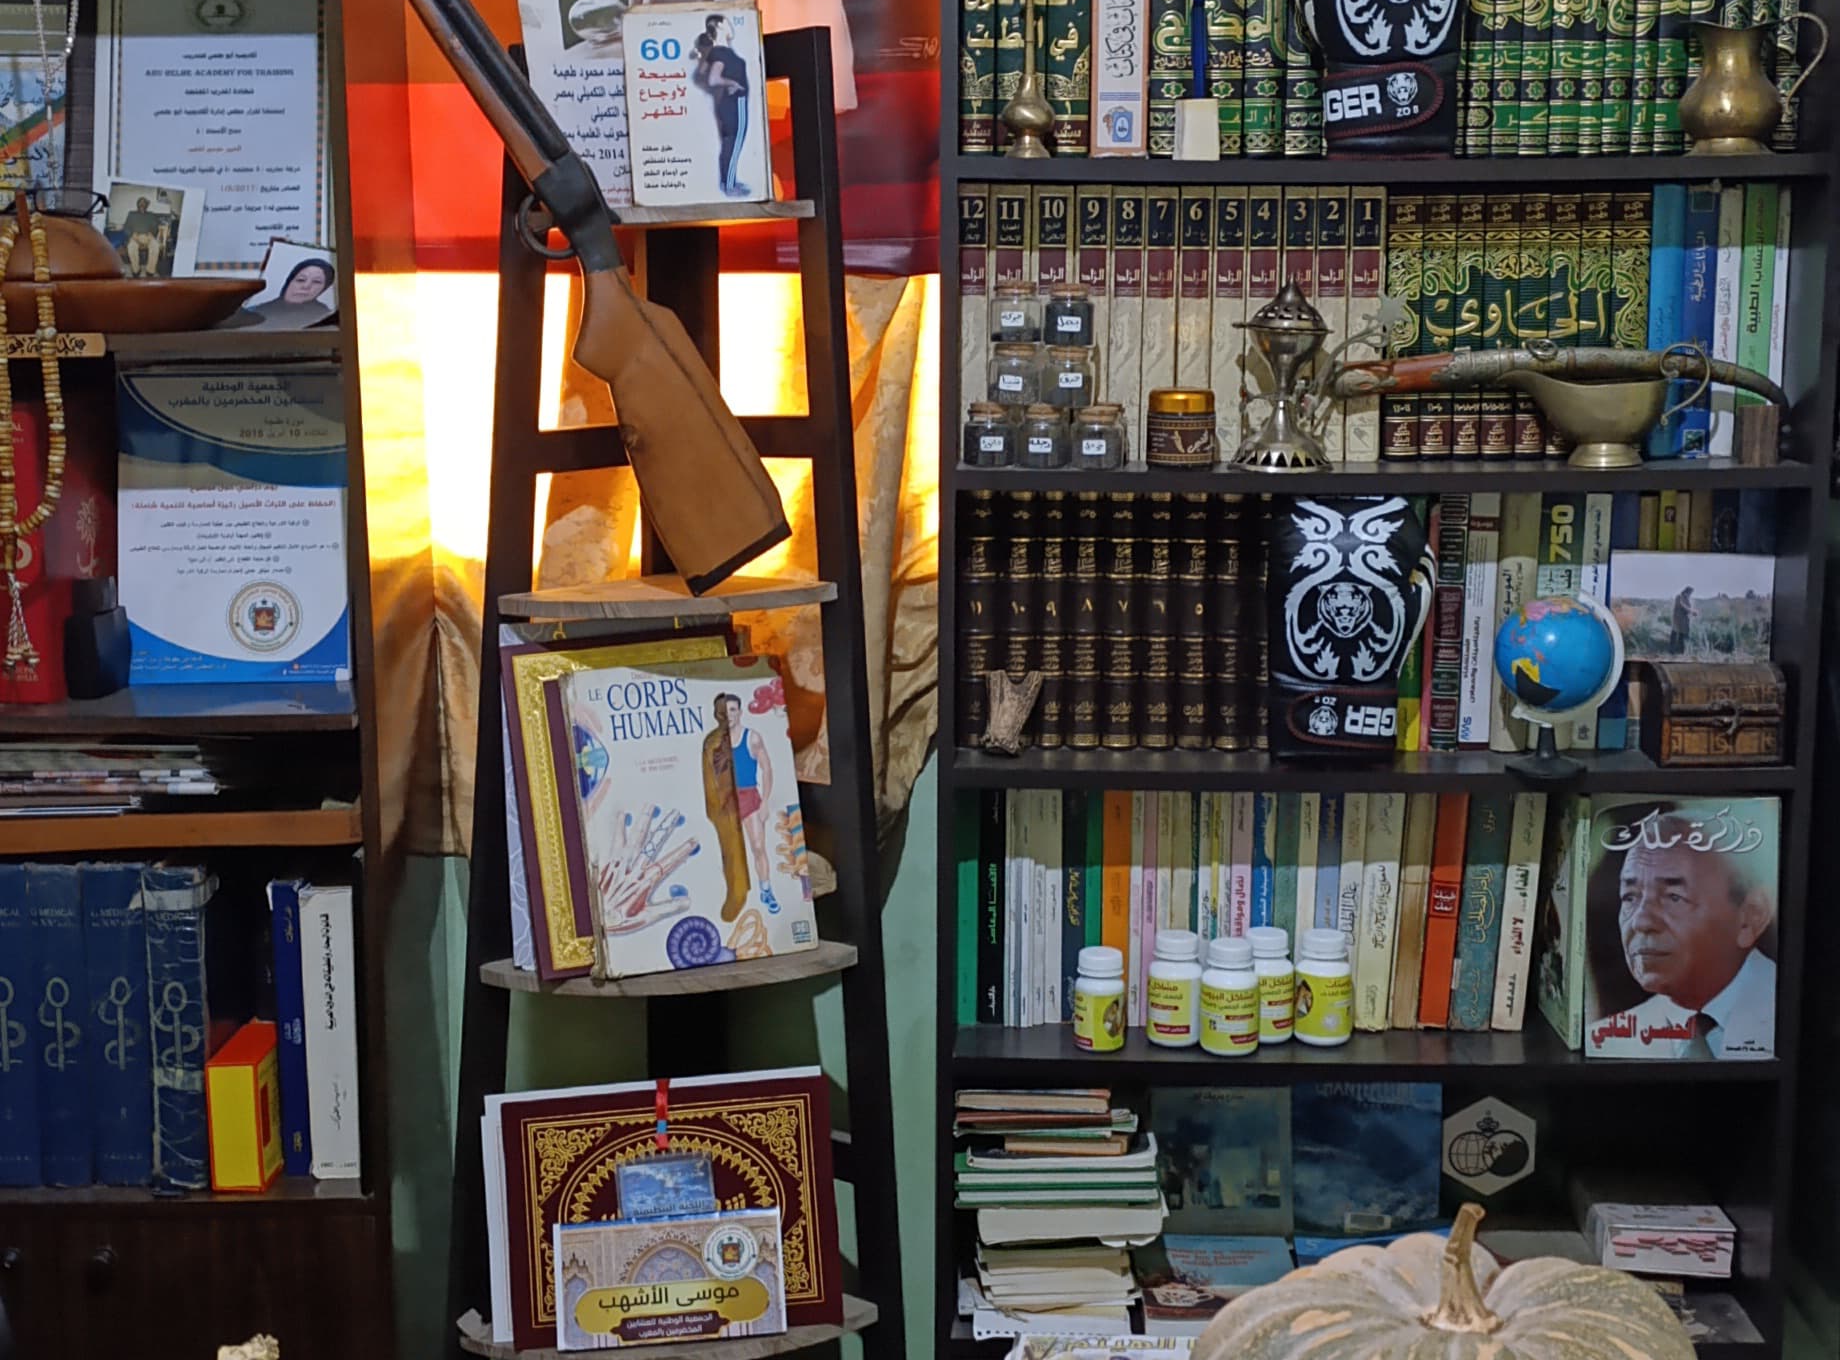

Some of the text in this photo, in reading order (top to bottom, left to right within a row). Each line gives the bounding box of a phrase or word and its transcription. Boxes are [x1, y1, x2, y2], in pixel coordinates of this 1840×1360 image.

[639, 38, 681, 61] 60
[194, 68, 236, 76] ACADEMY
[237, 68, 253, 76] FOR
[255, 68, 294, 76] TRAINING
[638, 67, 687, 82] نصيحة
[641, 106, 688, 120] الظهر
[1322, 84, 1383, 123] GER
[599, 148, 625, 160] 2014
[961, 198, 985, 220] 12
[1000, 200, 1021, 220] 11
[1042, 198, 1065, 219] 10
[1088, 199, 1099, 219] 9
[1121, 200, 1136, 220] 8
[1156, 200, 1169, 221] 7
[1189, 200, 1203, 221] 6
[1225, 200, 1238, 221] 5
[1257, 200, 1271, 220] 4
[1293, 200, 1307, 221] 3
[1326, 200, 1340, 220] 2
[1362, 200, 1373, 221] 1
[1424, 288, 1606, 346] الحاوي
[1746, 282, 1760, 334] الطبية
[1549, 504, 1574, 562] 750
[1502, 568, 1512, 616] الموسوع
[588, 688, 602, 702] LE
[606, 677, 689, 712] CORPS
[610, 705, 705, 742] HUMAIN
[1343, 704, 1396, 737] GER
[1687, 805, 1763, 853] ذاكرة
[1591, 1012, 1698, 1048] الحسن الثاني
[598, 1284, 740, 1314] موسى الأشهب
